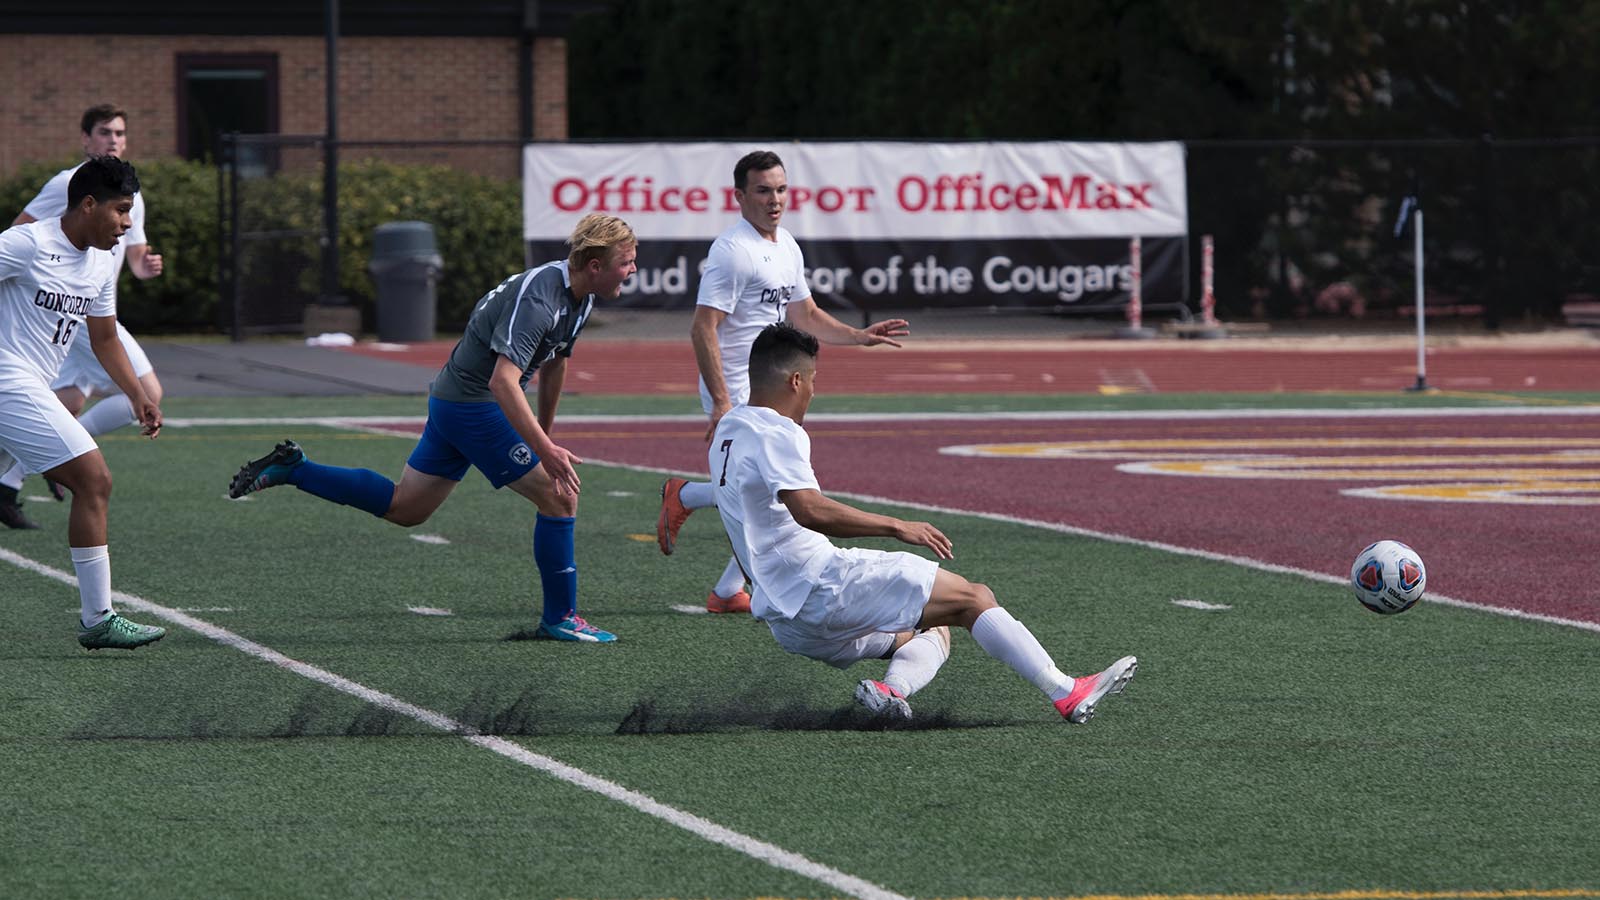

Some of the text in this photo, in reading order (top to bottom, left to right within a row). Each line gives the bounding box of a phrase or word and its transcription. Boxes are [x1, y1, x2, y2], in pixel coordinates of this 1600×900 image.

[552, 176, 709, 212] Office
[897, 173, 1153, 212] OfficeMax
[620, 256, 688, 294] oud
[862, 255, 903, 294] of
[912, 255, 973, 294] the
[982, 256, 1135, 302] Cougars
[52, 317, 78, 346] 16
[719, 439, 734, 487] 7
